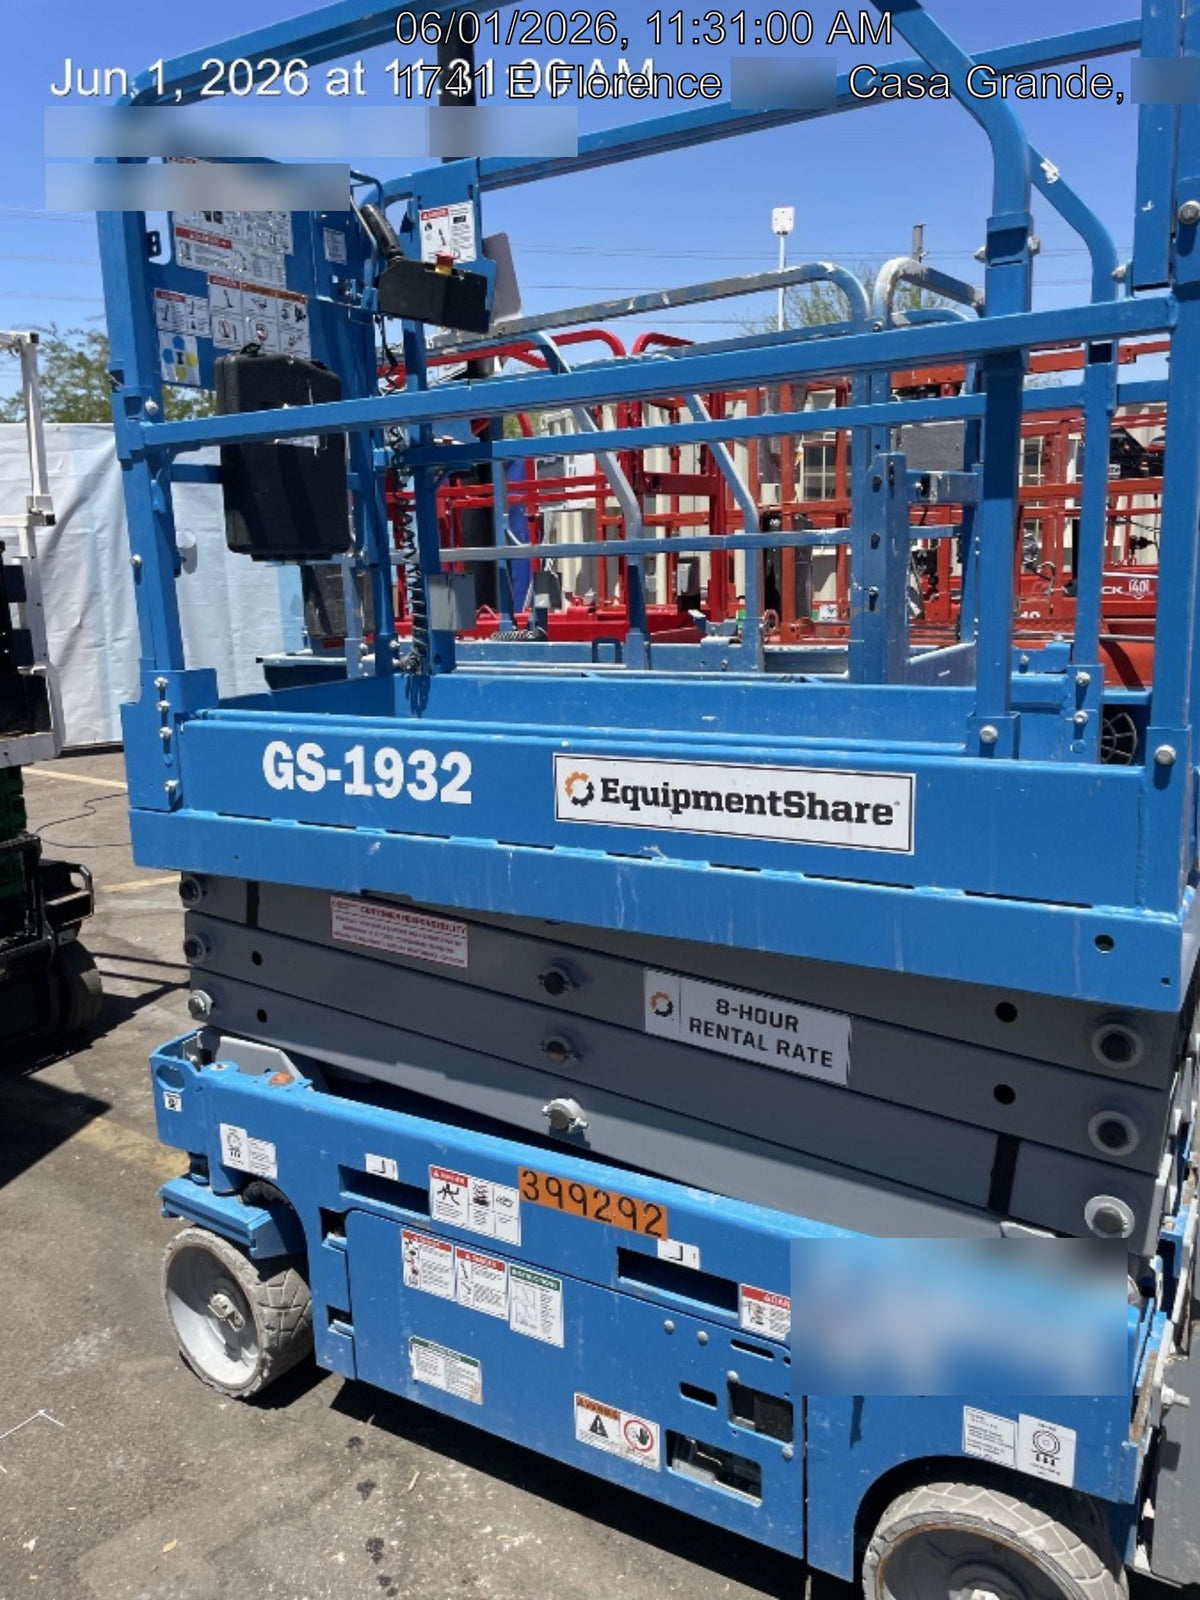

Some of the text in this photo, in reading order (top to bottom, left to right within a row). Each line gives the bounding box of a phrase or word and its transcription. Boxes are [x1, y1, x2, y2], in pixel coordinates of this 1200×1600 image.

[262, 740, 472, 804] GS-1932
[601, 777, 894, 826] EquipmentShare
[715, 998, 799, 1033] 8-HOUR
[689, 1016, 833, 1068] RENTAL RATE
[521, 1170, 663, 1238] 399292
